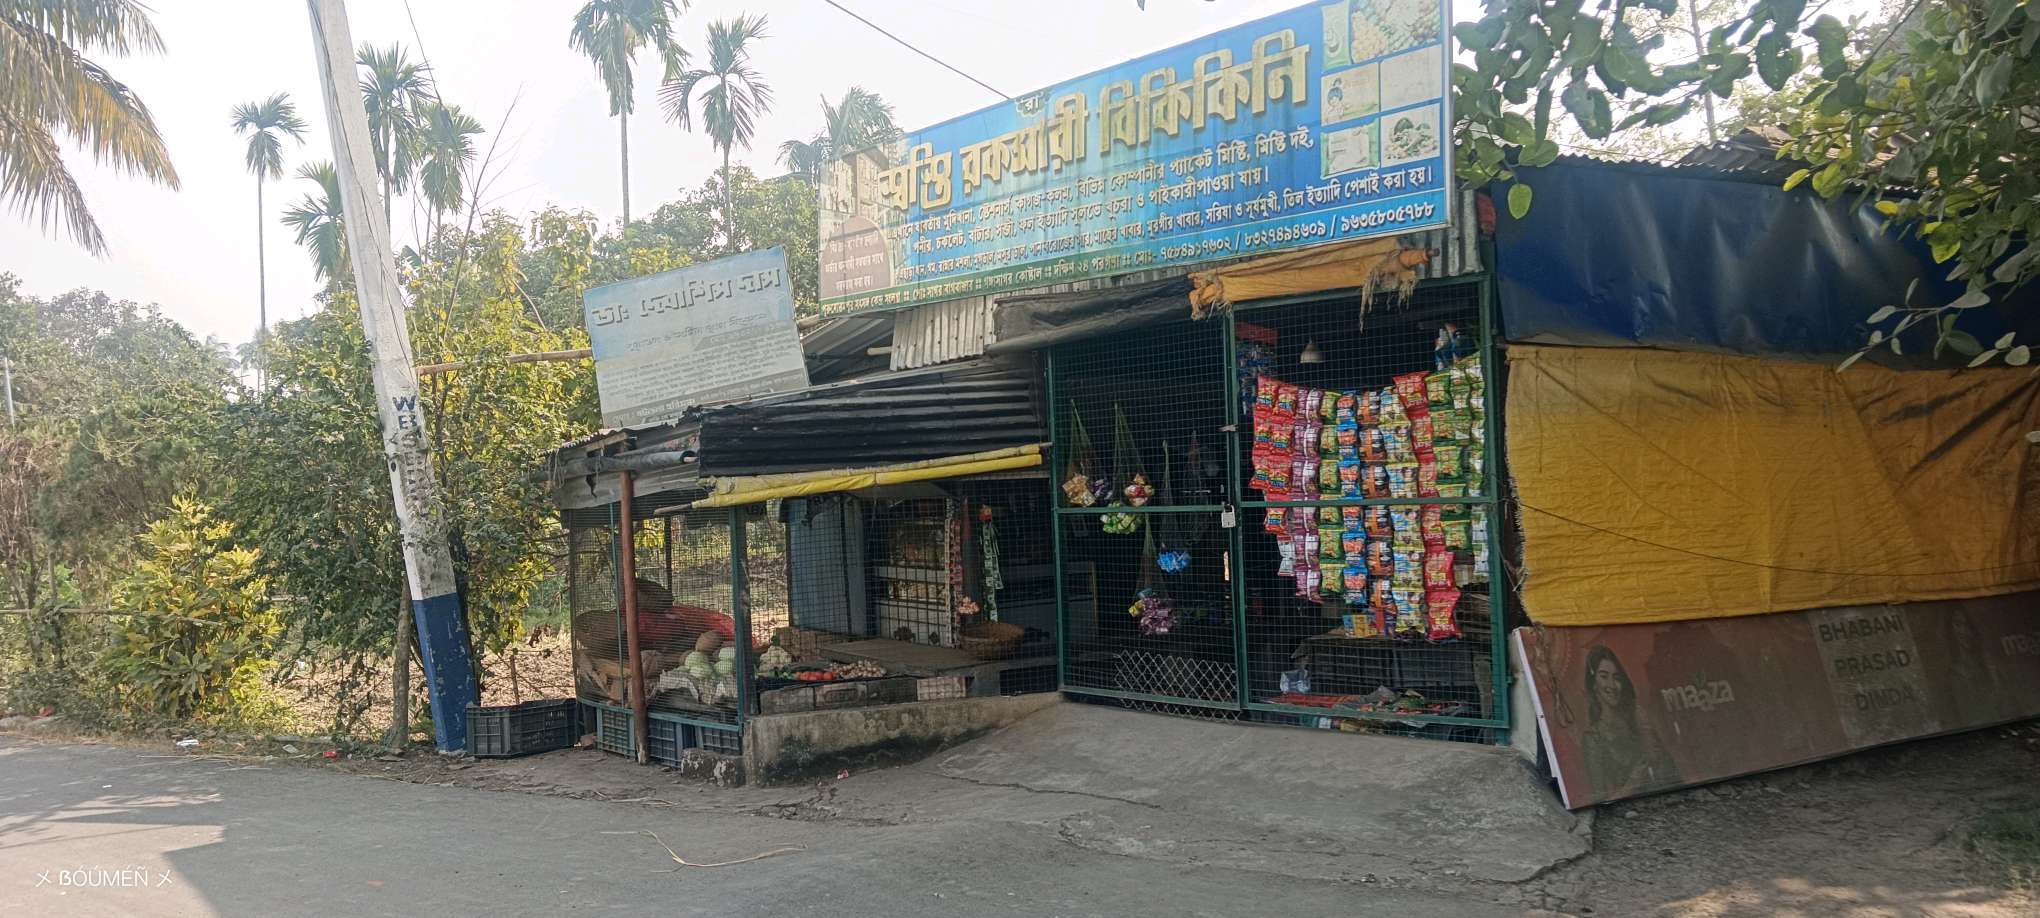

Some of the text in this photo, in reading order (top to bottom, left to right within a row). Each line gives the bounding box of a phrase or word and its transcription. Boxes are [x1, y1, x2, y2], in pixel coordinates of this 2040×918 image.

[876, 142, 952, 211] স্বস্তি
[1097, 28, 1311, 156] বিকিকিনি
[1075, 175, 1106, 198] বিভিন্ন
[1110, 160, 1166, 191] কোম্পানীর
[1169, 149, 1213, 177] প্যাকেট
[1217, 141, 1251, 167] মিষ্টি,
[1255, 129, 1287, 158] মিষ্টি
[1290, 125, 1314, 149] দই,
[1037, 206, 1068, 231] ইত্যাদি
[1071, 203, 1103, 223] সুলভে
[1106, 195, 1133, 219] খুচরা
[1136, 193, 1146, 208] ও
[1176, 210, 1204, 229] খাবার,
[1205, 201, 1233, 222] সরিষা
[1235, 204, 1244, 218] ও
[1245, 190, 1281, 220] সূর্যমুখী,
[1283, 187, 1304, 210] তিল
[1306, 178, 1341, 207] ইত্যাদি
[1344, 172, 1381, 199] পেশাই
[1383, 170, 1406, 191] করা
[1077, 259, 1089, 273] ২৪
[1244, 219, 1326, 246] ৮৩২৭৪৯৪৬০৯
[1340, 201, 1435, 232] ৯৬৩৫৮০৫৭৮৮
[1818, 614, 1905, 642] BHABANI
[1834, 649, 1911, 673] PRASAD
[1660, 680, 1735, 713] maaza
